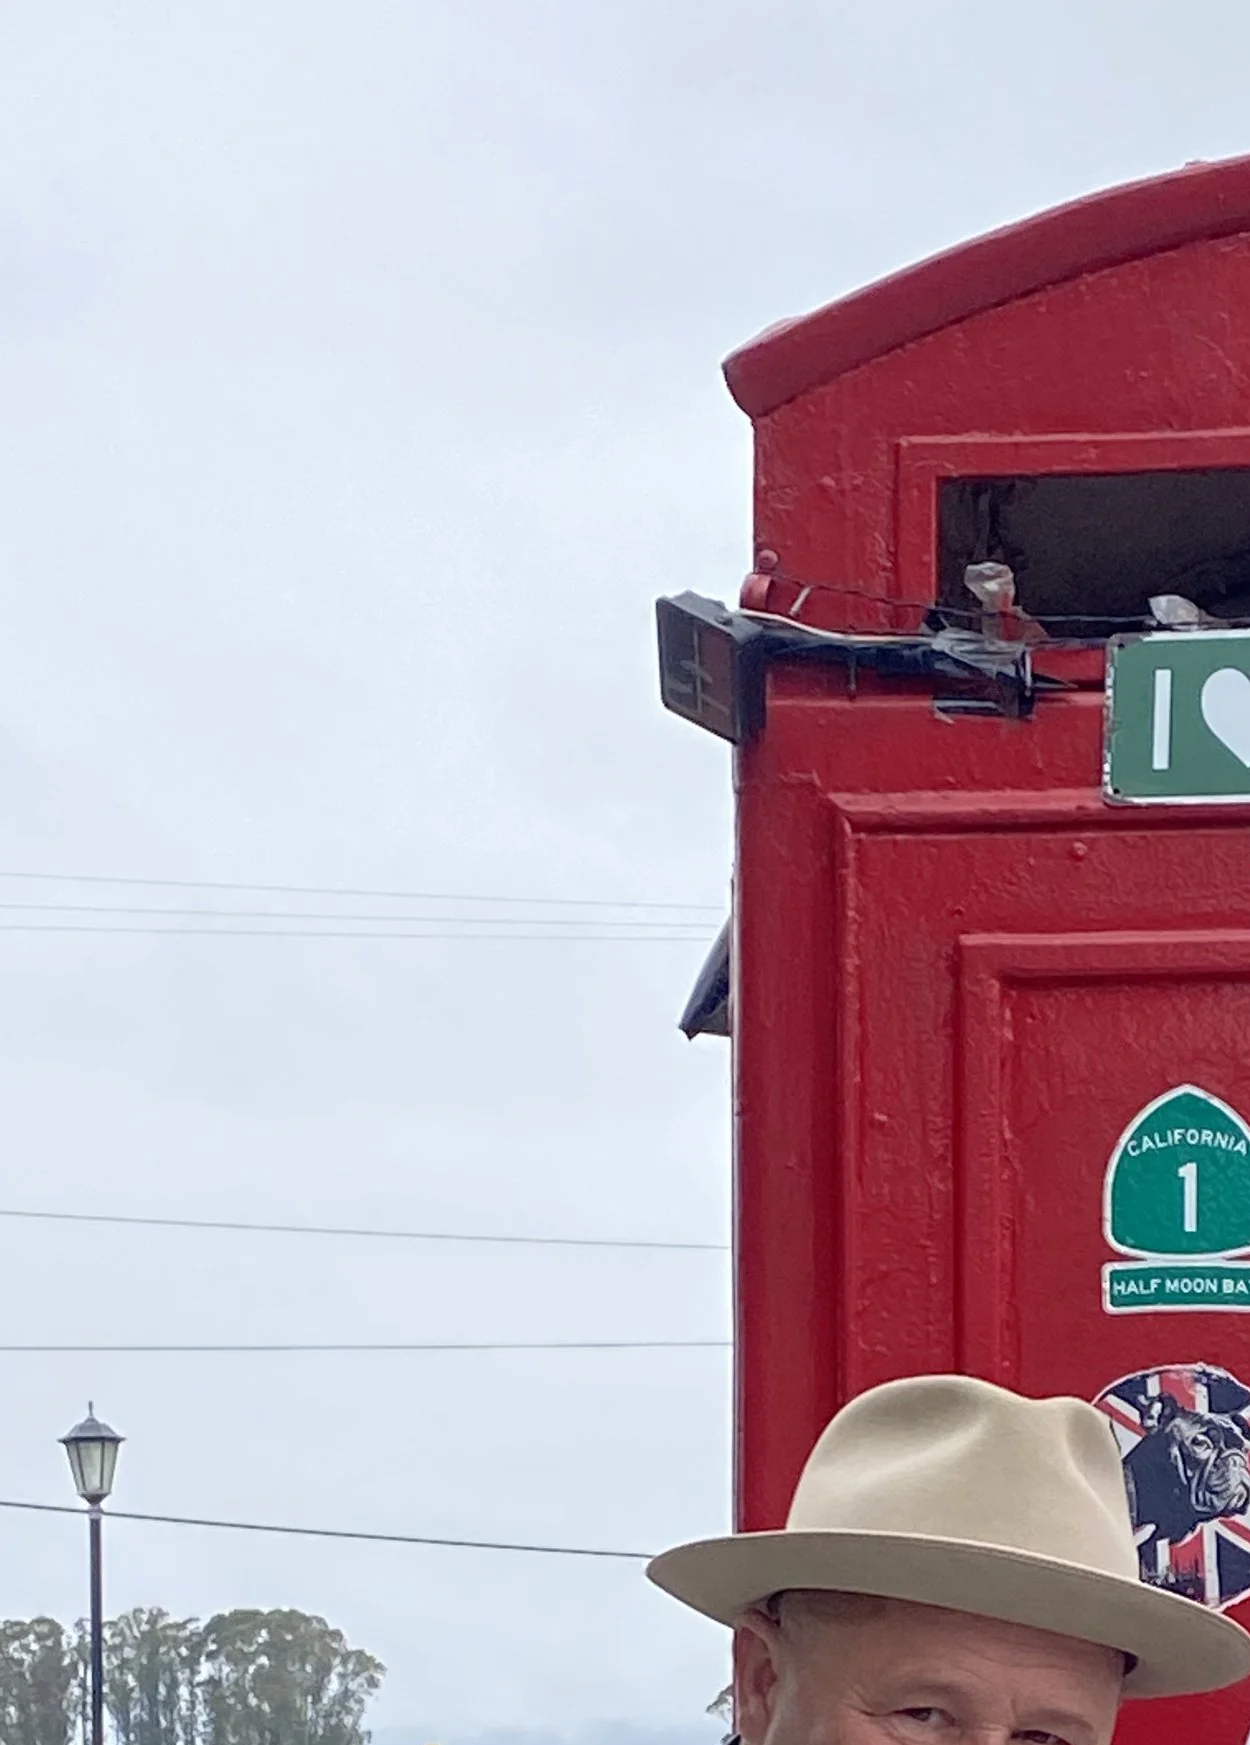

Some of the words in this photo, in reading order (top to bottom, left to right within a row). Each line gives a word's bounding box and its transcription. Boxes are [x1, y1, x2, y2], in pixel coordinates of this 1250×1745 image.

[1151, 667, 1172, 771] I
[1127, 1128, 1248, 1157] CALIFORNIA
[1177, 1162, 1198, 1233] 1
[1112, 1279, 1161, 1296] HALF
[1165, 1278, 1218, 1294] MOON
